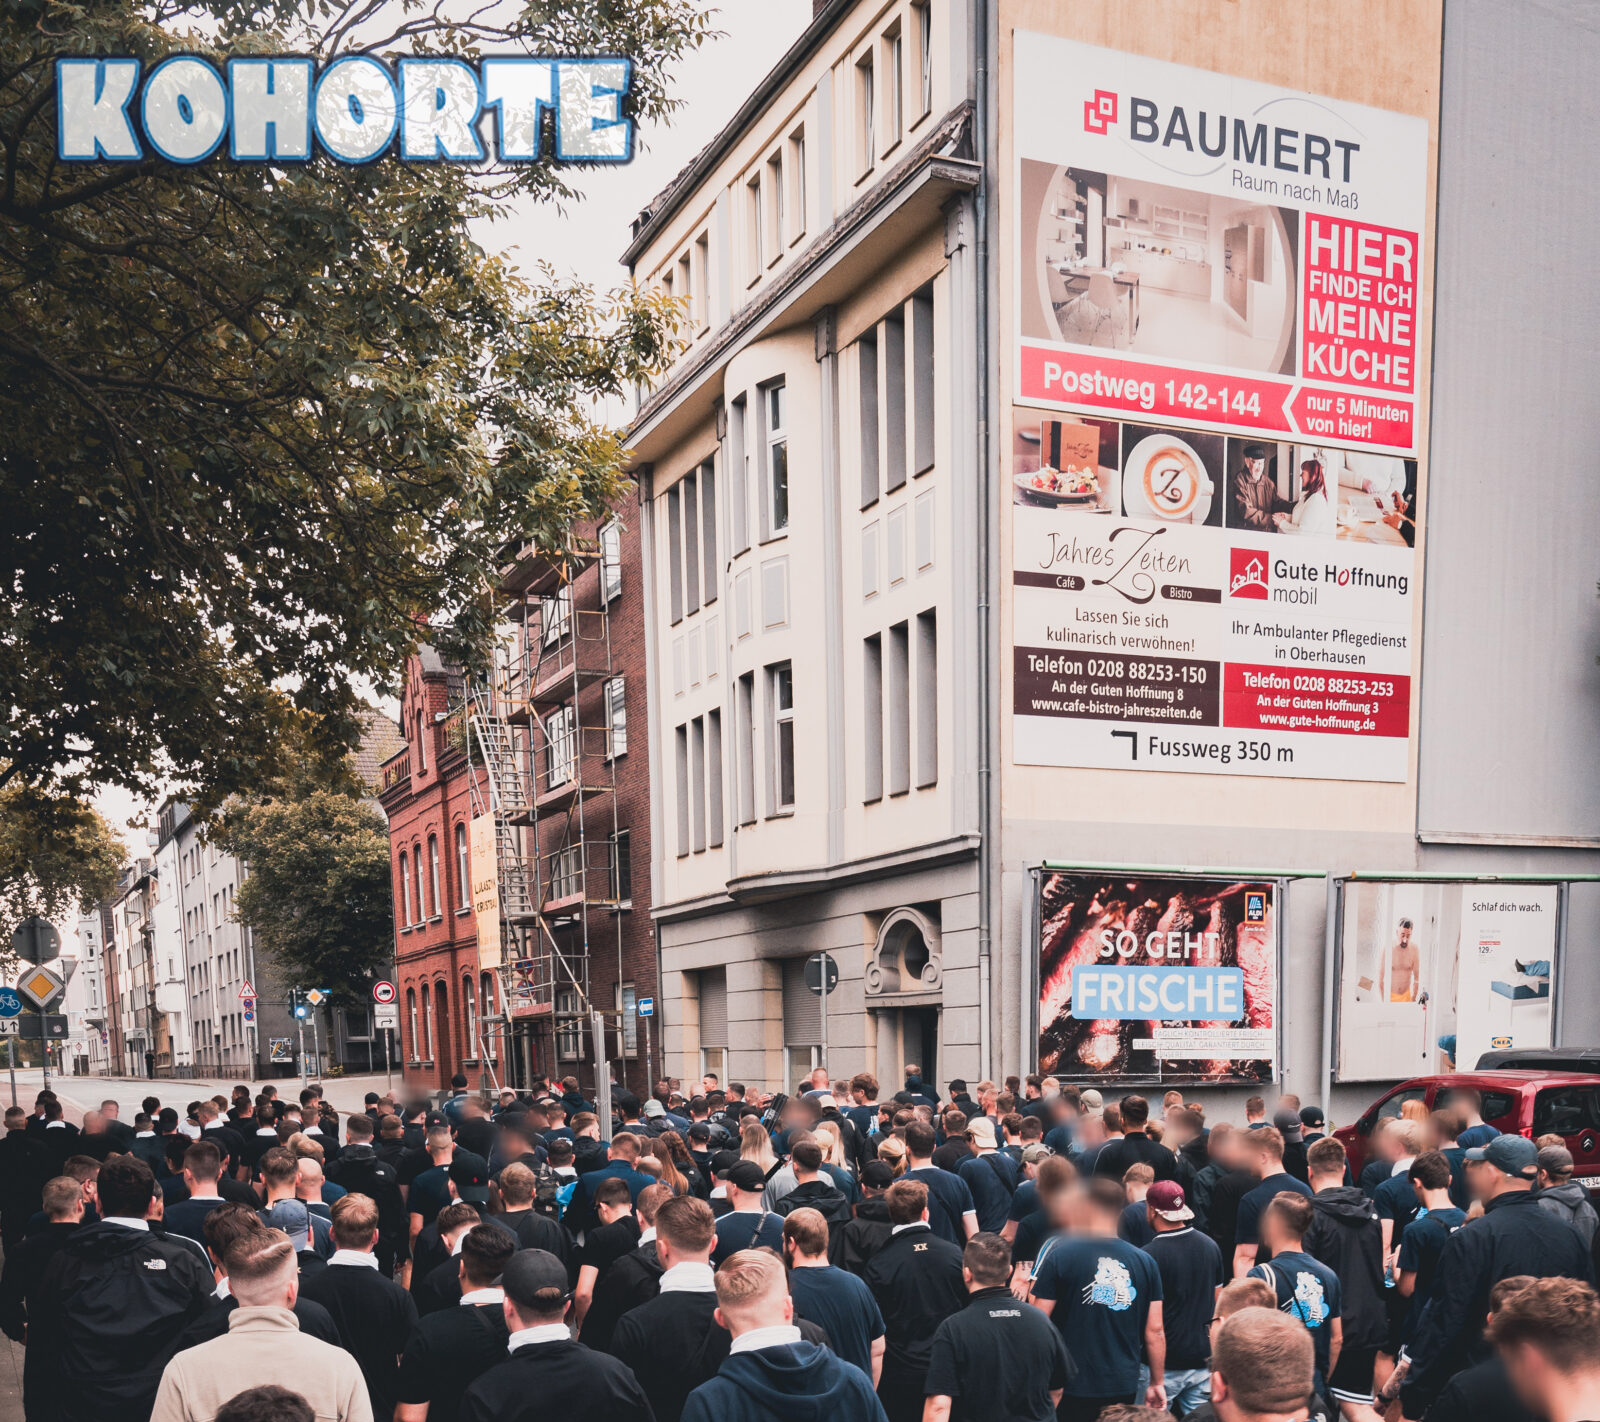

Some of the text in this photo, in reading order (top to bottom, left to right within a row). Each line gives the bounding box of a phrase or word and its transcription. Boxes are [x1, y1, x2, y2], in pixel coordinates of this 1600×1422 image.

[1130, 96, 1360, 183] BAUMERT
[1232, 169, 1359, 210] Raum nach Maß
[1310, 220, 1413, 282] HIER
[1309, 270, 1413, 308] FINDE ICH
[1308, 298, 1411, 347] MEINE
[1307, 338, 1410, 387] KÜCHE
[1043, 361, 1262, 418] Postweg 142-144
[1306, 395, 1410, 424] nur 5 Minuten
[1306, 417, 1373, 439] von hier!
[1056, 575, 1193, 601] Café Bistro
[1274, 559, 1409, 595] Gute Hoffnung
[1273, 585, 1318, 606] mobil
[1075, 607, 1169, 629] Lassen Sie sich
[1046, 626, 1196, 653] kulinarisch verwöhnen!
[1232, 620, 1407, 650] Ihr Ambulanter Pflegedienst
[1028, 654, 1208, 685] Telefon 0208 88253-150
[1275, 645, 1366, 666] in Oberhausen
[1051, 679, 1184, 703] An der Guten Hoffnung 8
[1243, 672, 1395, 697] Telefon 0208 88253-253
[1031, 698, 1203, 720] www.cafe-bistro-jahreszeiten.de
[1256, 694, 1380, 716] An der Guten Hoffnung 3
[1259, 712, 1376, 733] www.gute-hoffnung.de
[1148, 737, 1294, 764] Fussweg 350 m
[1472, 902, 1543, 912] Schlaf dich wach.
[1099, 929, 1220, 959] SO GEHT
[1077, 973, 1238, 1013] FRISCHE
